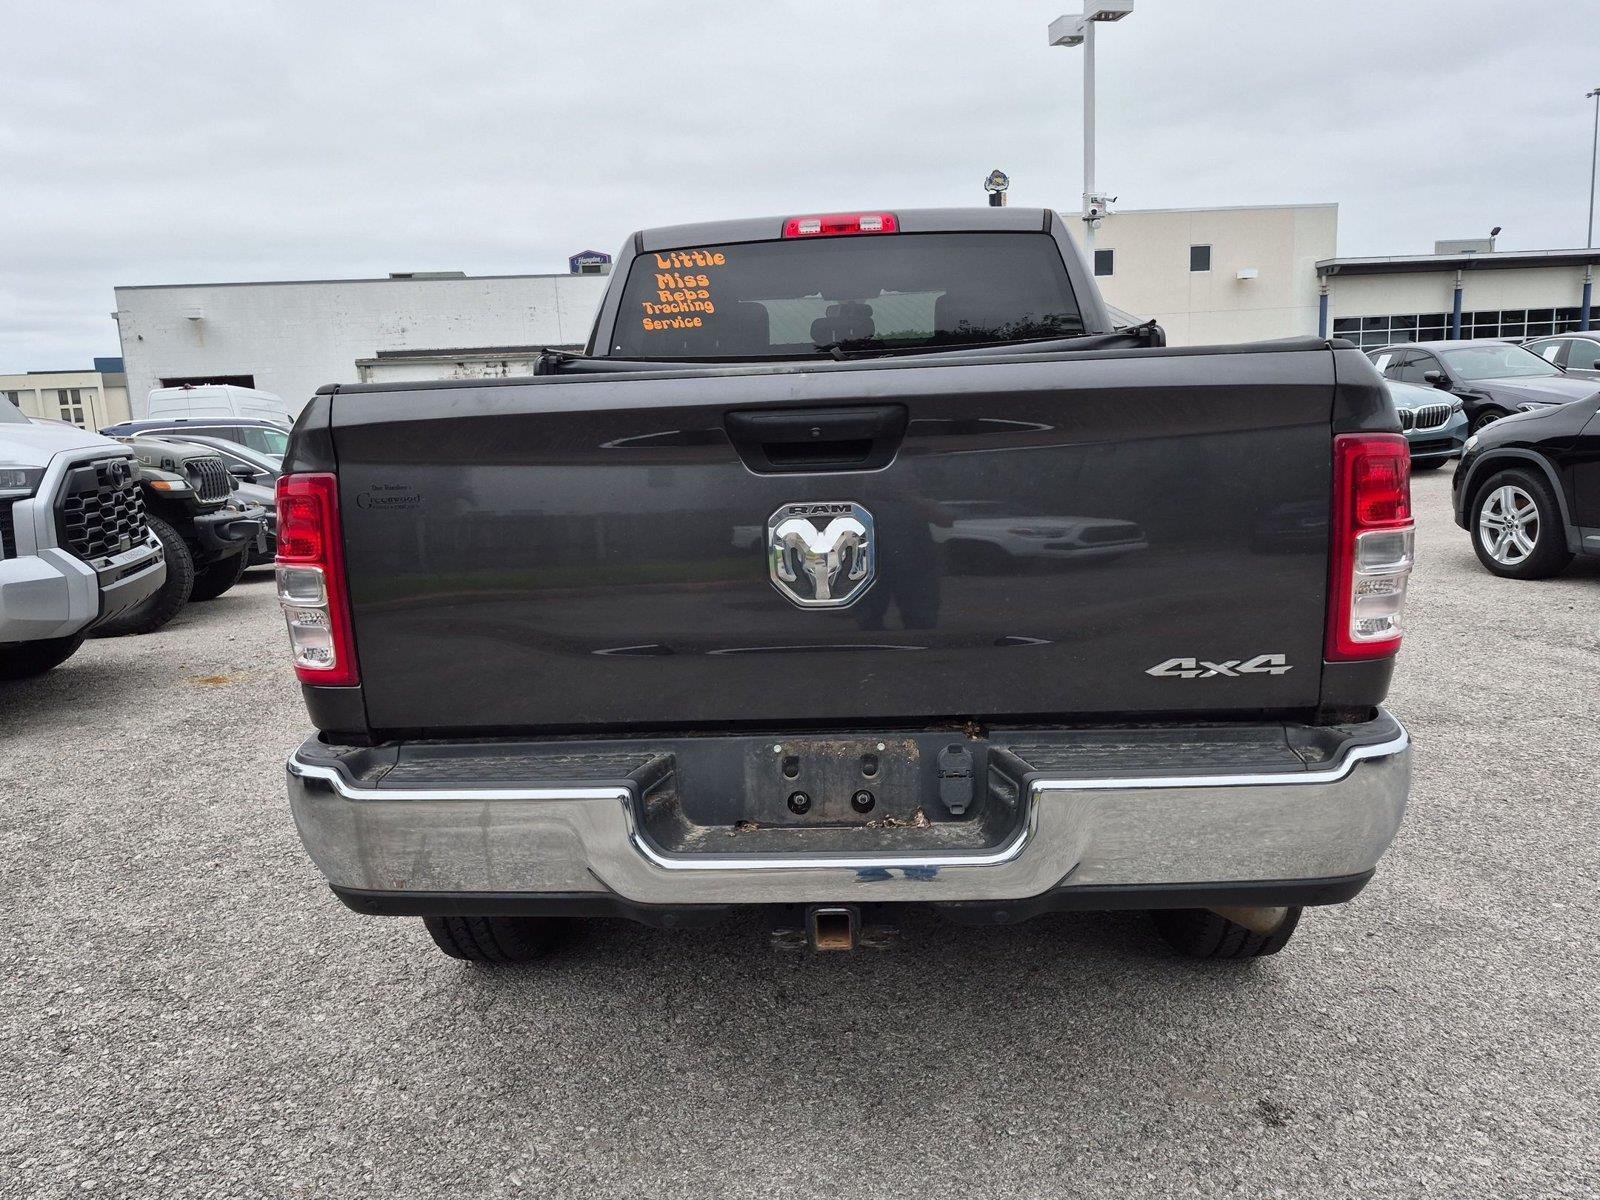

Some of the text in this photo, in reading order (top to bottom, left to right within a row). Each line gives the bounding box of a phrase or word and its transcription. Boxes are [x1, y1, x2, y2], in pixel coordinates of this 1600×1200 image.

[654, 250, 726, 269] Little
[655, 272, 710, 289] Miss
[657, 288, 710, 302] Reba
[642, 300, 715, 315] Tracking
[642, 316, 703, 331] Service
[788, 504, 852, 514] RAM
[1144, 653, 1294, 679] 4x4
